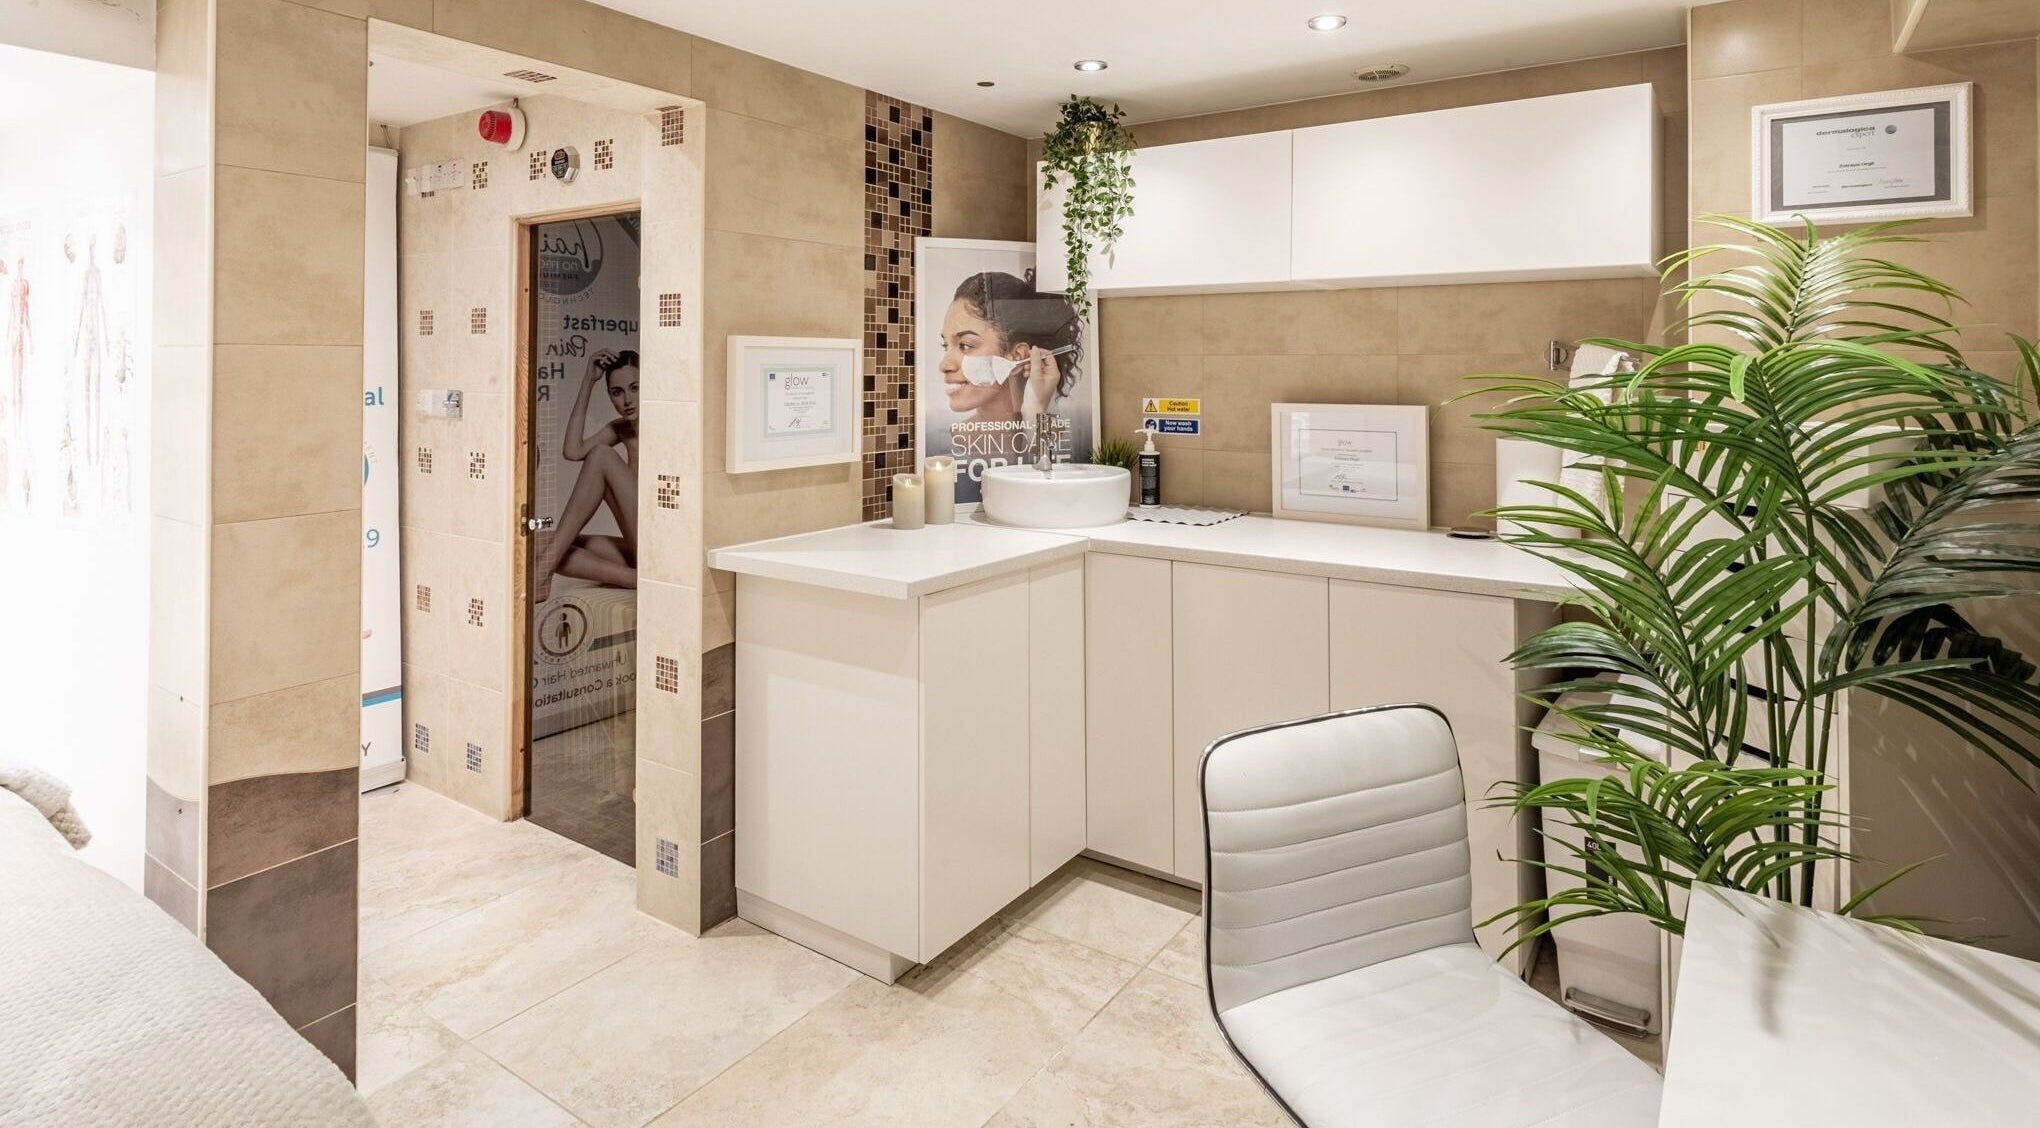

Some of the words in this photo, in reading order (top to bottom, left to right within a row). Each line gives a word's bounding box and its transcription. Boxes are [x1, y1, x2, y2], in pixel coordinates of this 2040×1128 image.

[1816, 127, 1876, 136] dermalogica
[784, 373, 809, 390] glow
[364, 386, 384, 407] al
[951, 418, 1071, 432] PROFESSIONAL-ADE
[951, 432, 1004, 457] SKIN
[367, 529, 380, 549] 9
[1587, 841, 1602, 851] 40L
